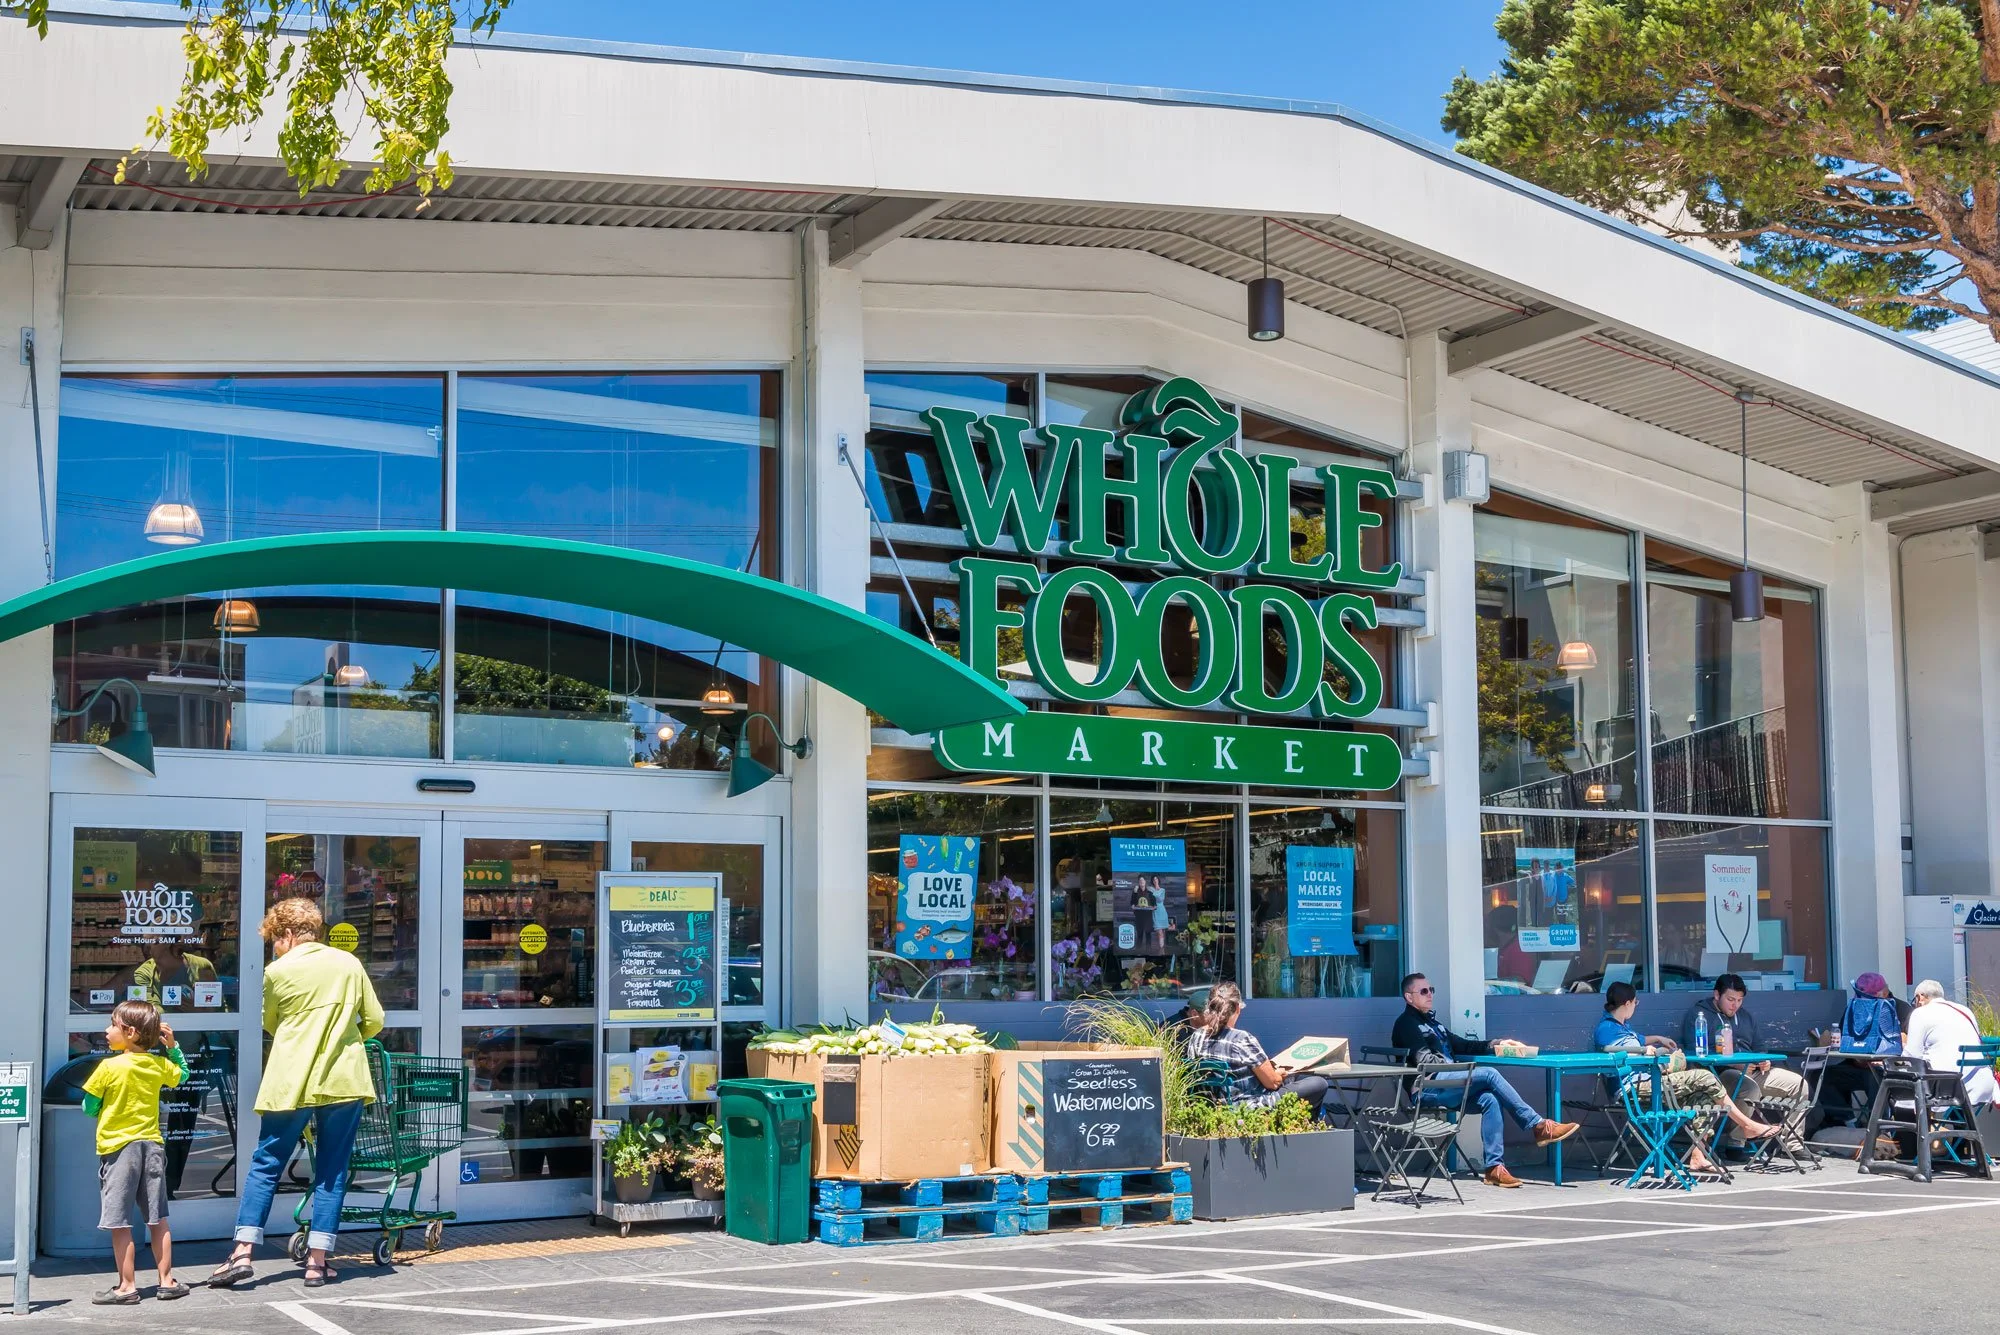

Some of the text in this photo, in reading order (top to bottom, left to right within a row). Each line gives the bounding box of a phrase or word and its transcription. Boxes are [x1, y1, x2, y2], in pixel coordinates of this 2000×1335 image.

[920, 377, 1402, 588] WHOLE
[950, 557, 1383, 719] FOODS
[982, 721, 1370, 777] MARKET
[1304, 870, 1336, 882] LOCAL
[1712, 864, 1752, 874] Sommelier
[924, 877, 962, 892] LOVE
[1298, 884, 1342, 896] MAKERS
[120, 882, 194, 908] WHOLE
[650, 890, 678, 902] DEALS
[918, 893, 966, 908] LOCAL
[124, 907, 193, 926] FOODS
[100, 992, 112, 1001] Pay
[1068, 1076, 1137, 1090] Seedless
[0, 1088, 14, 1096] OT
[2, 1098, 20, 1107] dog
[1053, 1092, 1155, 1112] Watermelons
[1102, 1138, 1116, 1146] EA
